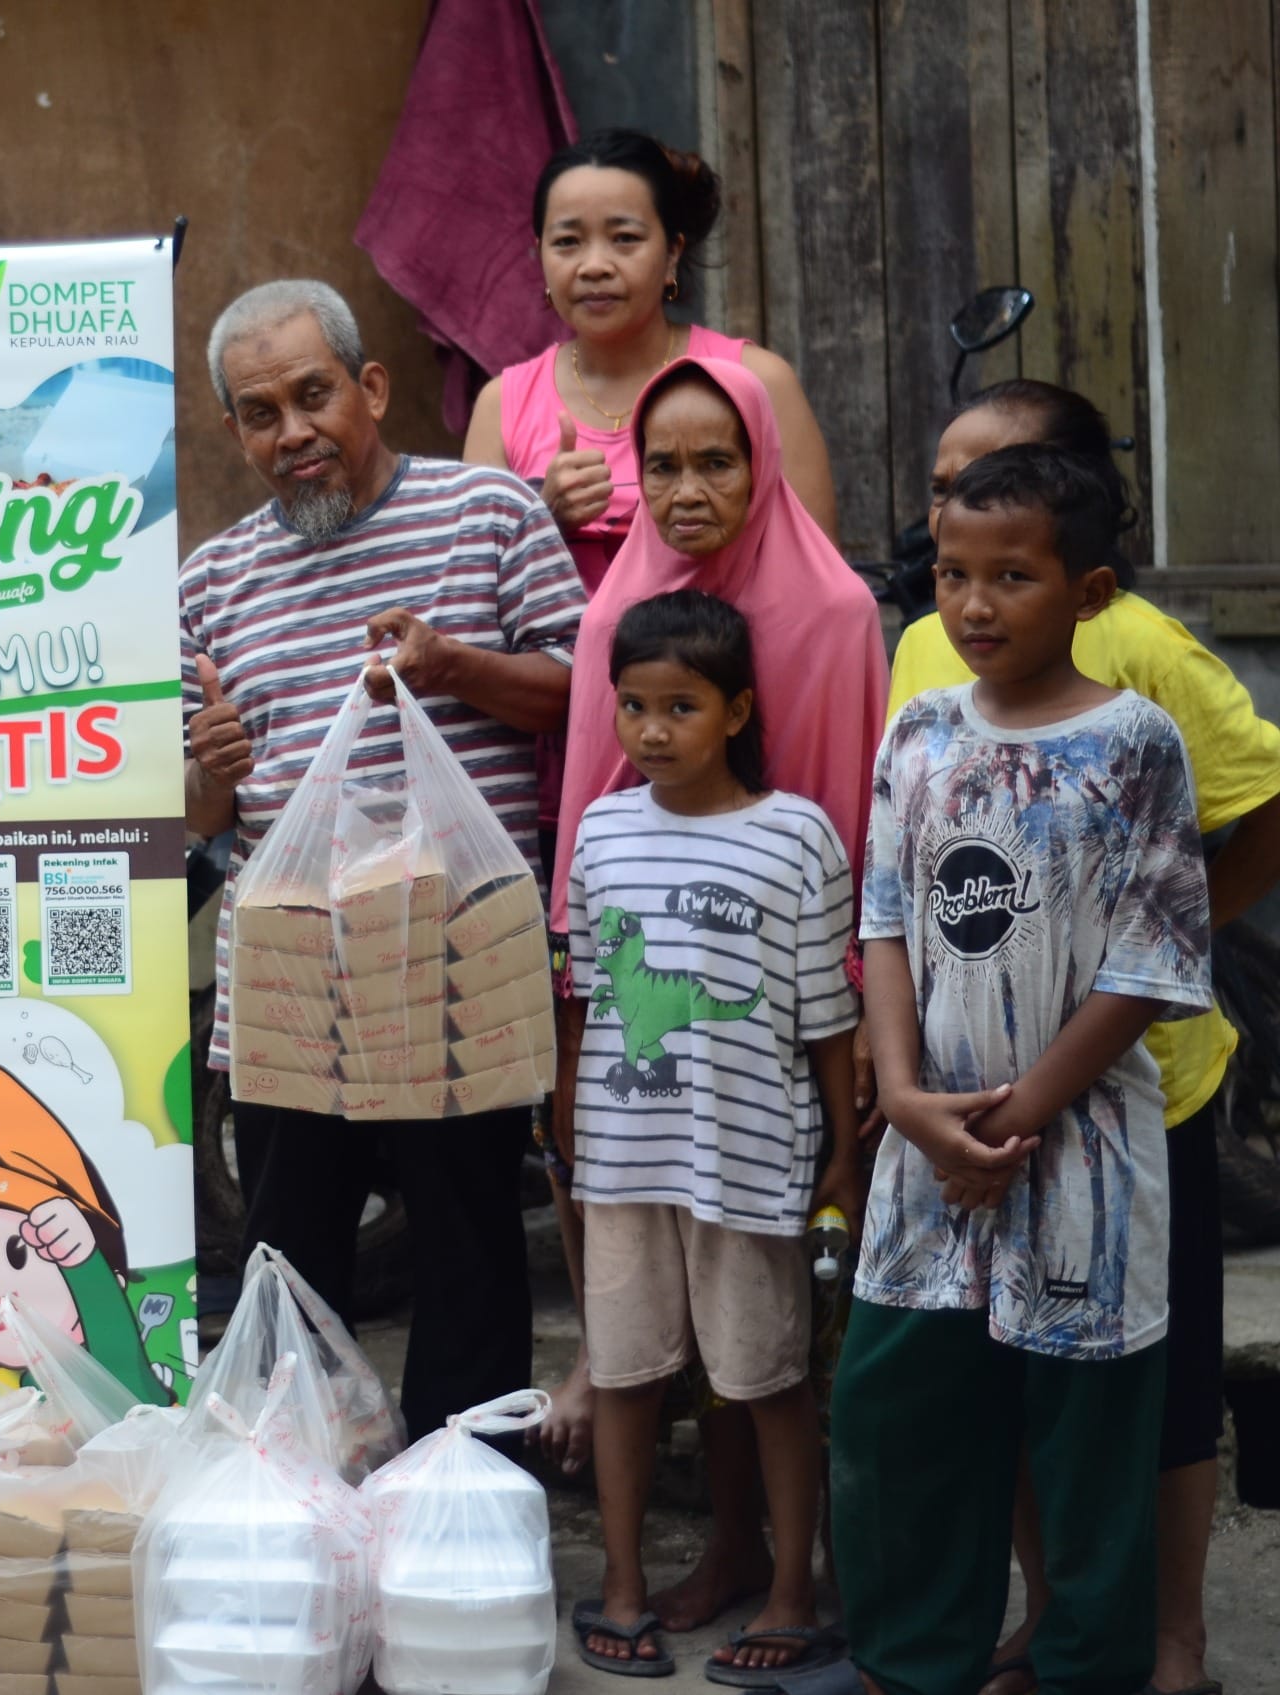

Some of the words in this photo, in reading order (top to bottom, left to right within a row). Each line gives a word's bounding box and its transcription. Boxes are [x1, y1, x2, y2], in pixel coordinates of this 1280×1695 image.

[8, 281, 136, 307] DOMPET
[9, 309, 138, 335] DHUAFA
[10, 335, 96, 349] KEPULAUAN
[105, 334, 139, 346] RIAU
[51, 829, 77, 847] ini,
[80, 828, 141, 845] melalui
[43, 858, 91, 868] Rekening
[92, 857, 119, 866] Infak
[43, 871, 69, 886] BSI
[45, 885, 124, 896] 756.0000.566
[926, 868, 1040, 925] Problem!
